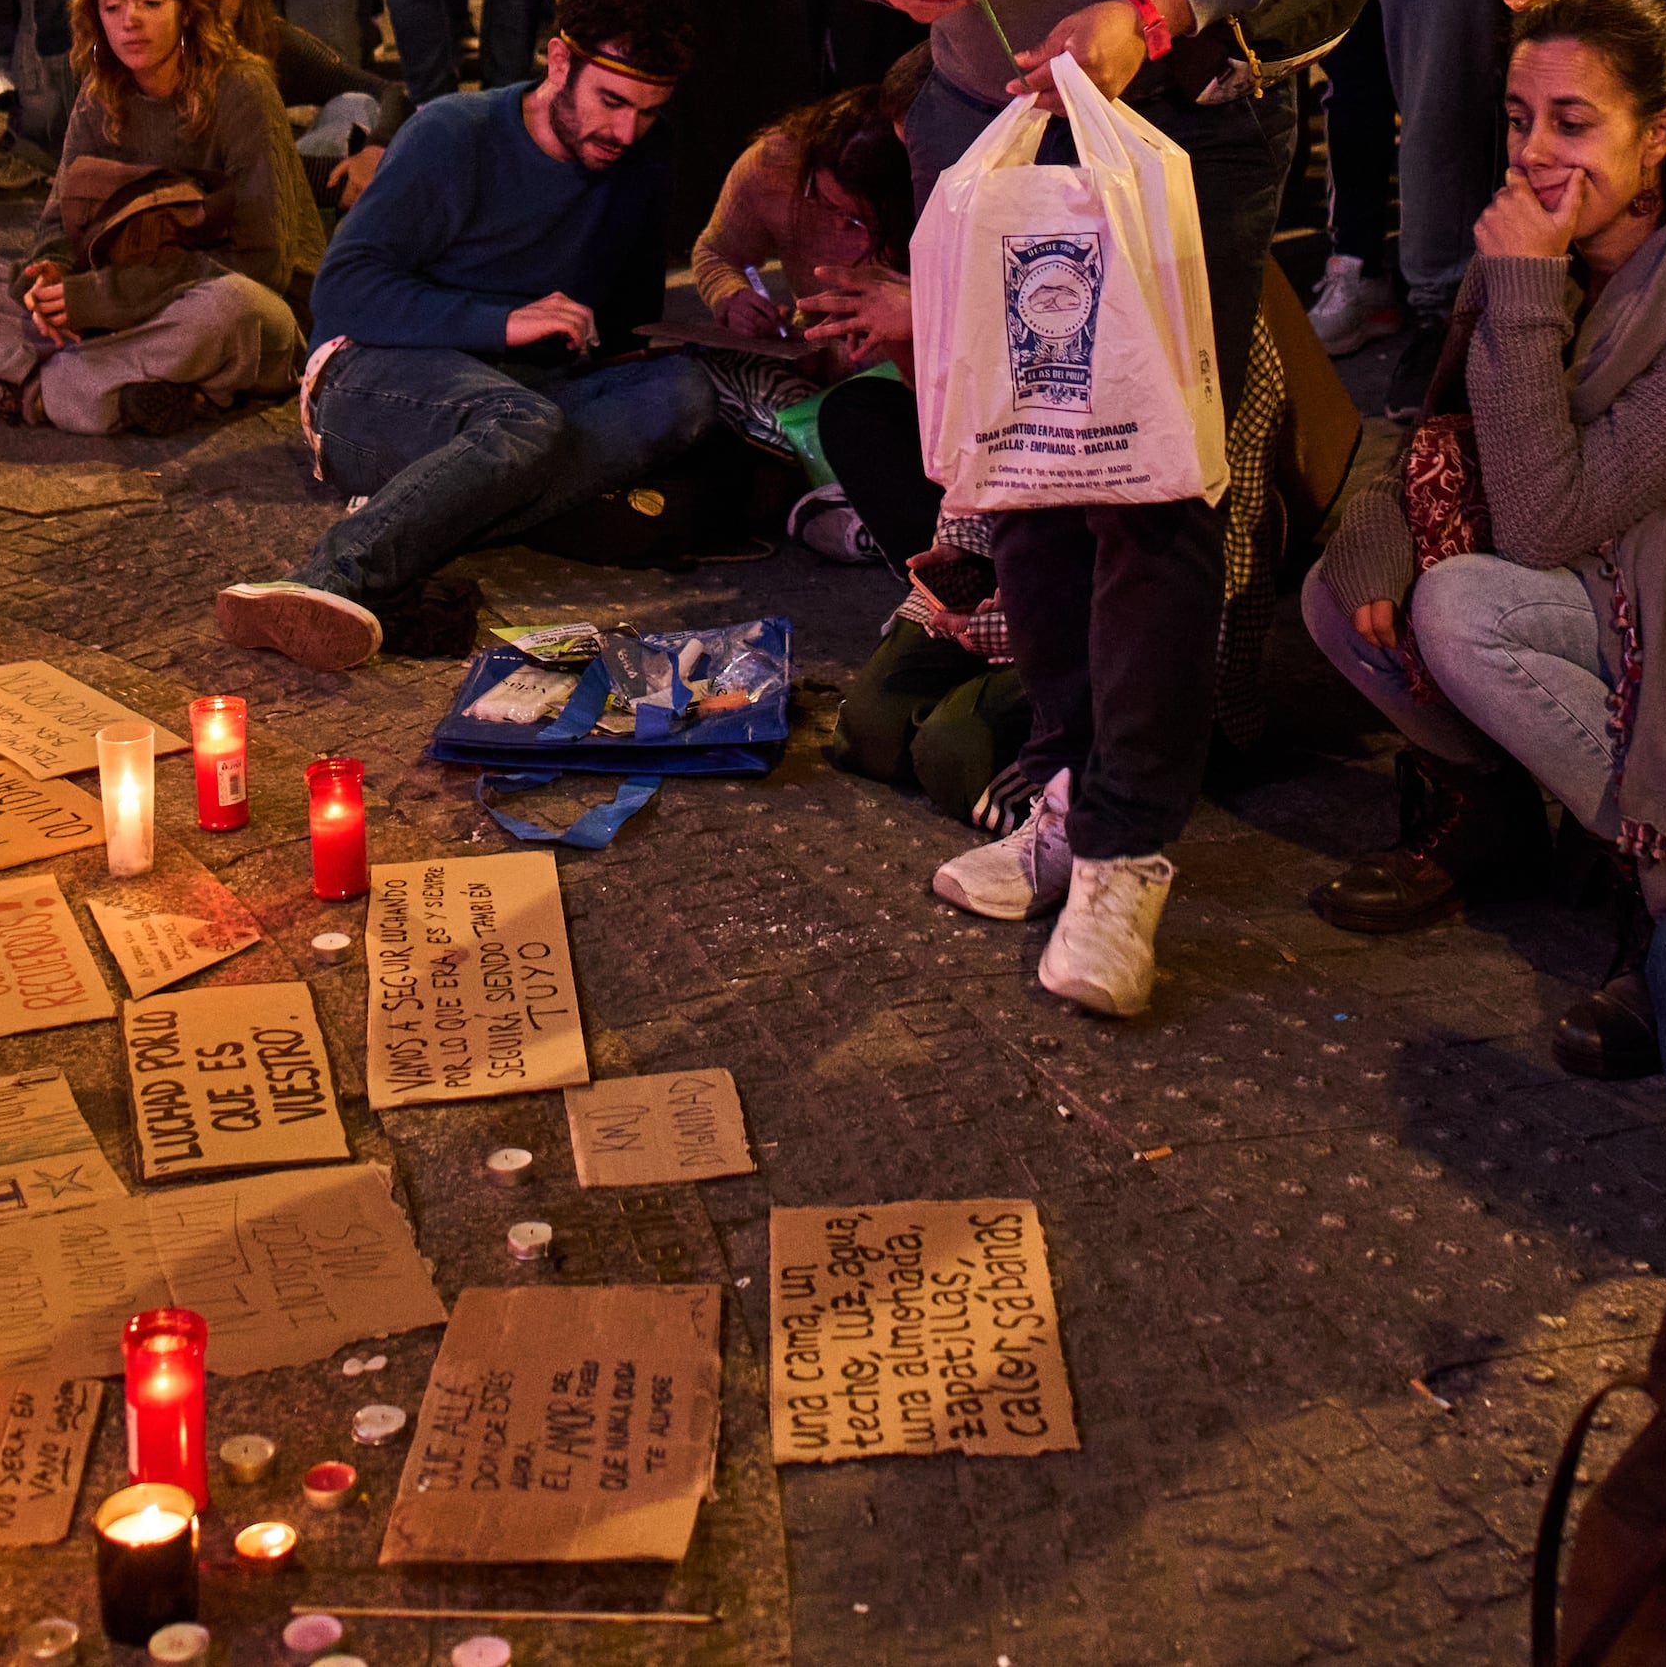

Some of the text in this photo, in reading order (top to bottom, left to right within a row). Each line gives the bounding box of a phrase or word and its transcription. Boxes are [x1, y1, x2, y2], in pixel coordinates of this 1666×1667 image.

[1038, 370, 1051, 380] AS
[1052, 369, 1065, 380] DEL
[1066, 370, 1086, 381] POLLO
[976, 421, 1138, 444] GRAN SURTIDO EN PLATOS PREPARADOS
[988, 438, 1129, 456] PAELLAS EMPANADAS BACALAO
[1107, 464, 1132, 474] MADRID
[1126, 474, 1151, 484] MADRID
[422, 866, 447, 906] SIEMPRE
[429, 909, 444, 921] Y
[431, 925, 452, 945] ES
[4, 912, 88, 1012] RECUERDOS
[469, 881, 525, 1078] SEGUIRÁ SIENDO TAMBIÉN
[382, 879, 433, 1094] VAMOS A SEGUIR LUCHANDO
[525, 940, 569, 1031] TUYO
[130, 1010, 177, 1030] LO
[436, 998, 468, 1033] QUE
[134, 1029, 181, 1072] POR
[441, 1034, 468, 1052] LO
[198, 1039, 261, 1134] QUE ES
[445, 1055, 471, 1089] POR
[669, 1076, 725, 1166] DIGNIDAD
[57, 1218, 140, 1324] AGUANTAMOS
[245, 1210, 337, 1329] INJUSTICIA
[782, 1262, 829, 1449] una cama, un
[885, 1223, 937, 1452] una almohada,
[927, 1256, 988, 1440] zapatillas,
[9, 1392, 34, 1418] EN
[838, 1348, 887, 1452] techo,
[424, 1382, 478, 1493] QUE ALLÁ
[471, 1370, 515, 1492] DONDE ESTÉS
[539, 1369, 595, 1493] EL AMOR DEL
[607, 1404, 633, 1450] NUNCA
[26, 1447, 58, 1501] VANO
[599, 1452, 628, 1492] QUE
[645, 1444, 671, 1475] TE
